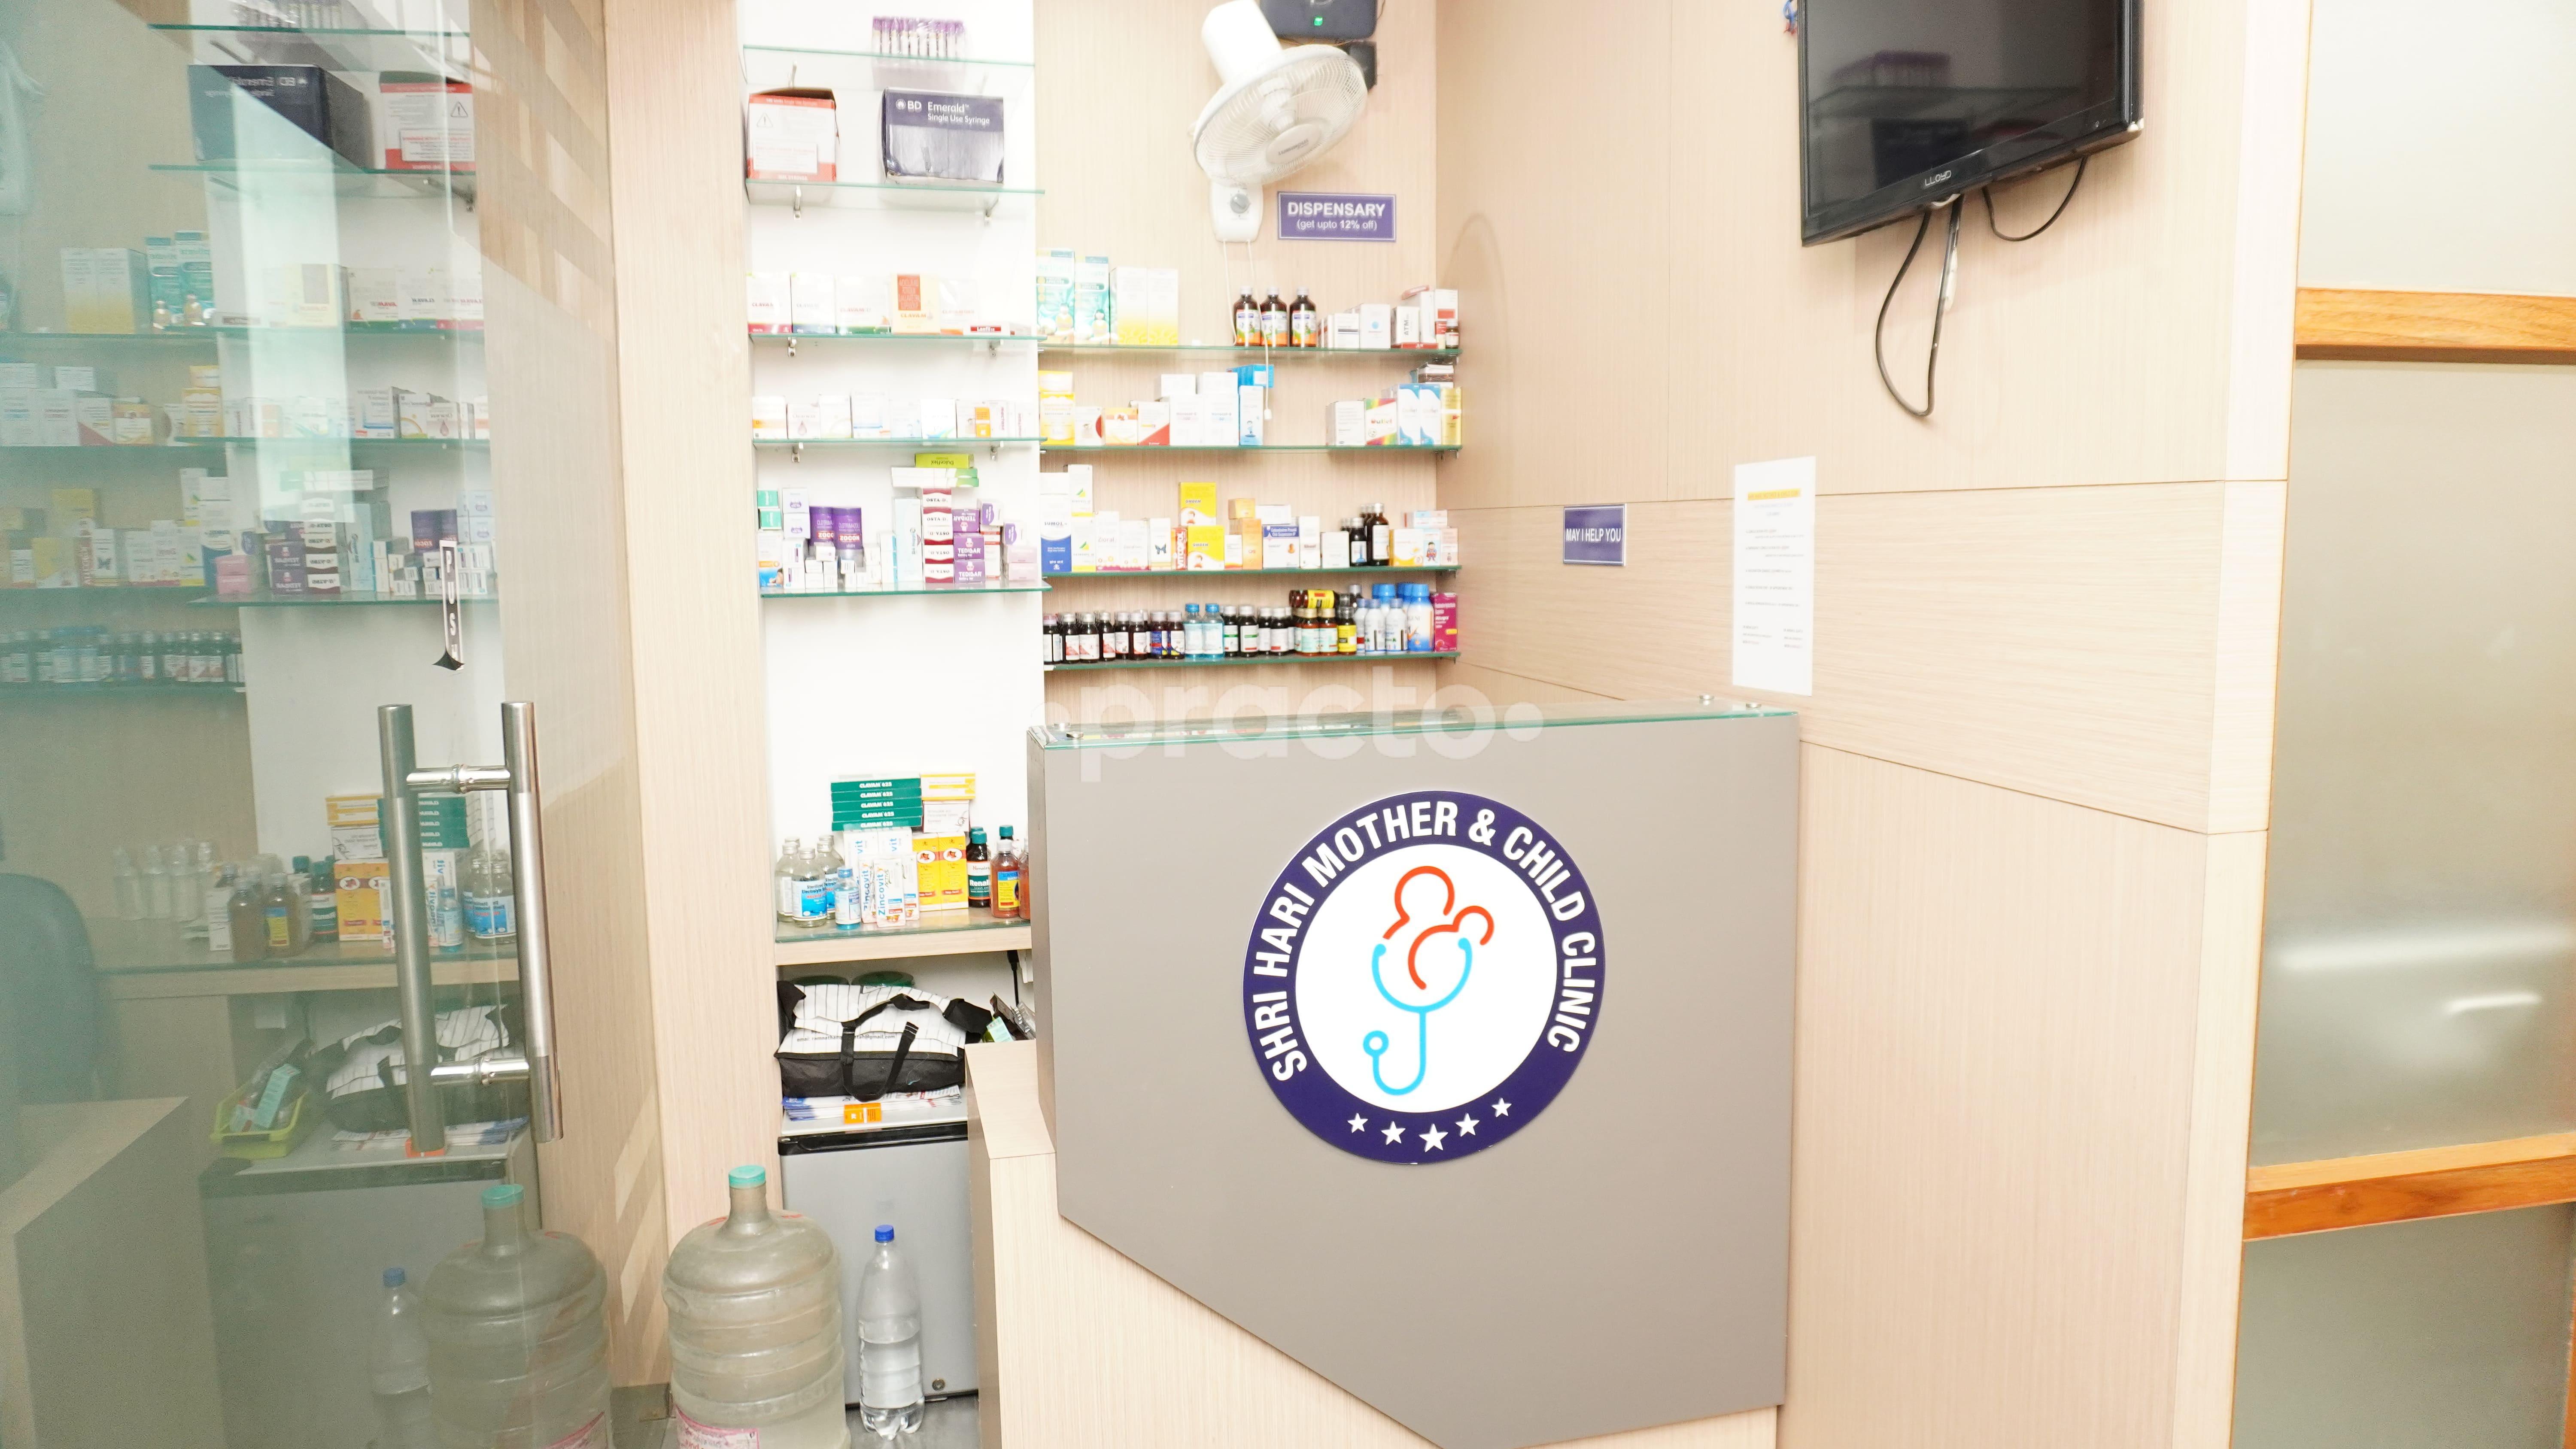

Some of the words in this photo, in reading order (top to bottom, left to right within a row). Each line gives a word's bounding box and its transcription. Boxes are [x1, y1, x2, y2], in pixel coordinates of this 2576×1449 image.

[908, 101, 921, 109] BD
[928, 113, 948, 122] Single
[965, 116, 990, 125] Syringe
[1925, 170, 1952, 186] LLOYD
[1288, 202, 1385, 216] DISPENSARY
[1297, 219, 1315, 230] (get
[1317, 220, 1337, 230] upto
[1340, 220, 1360, 229] 12%
[1362, 220, 1377, 230] off)
[1566, 528, 1580, 541] MAY
[1582, 528, 1584, 541] I
[1586, 528, 1604, 542] HELP
[1605, 528, 1621, 542] YOU
[1303, 801, 1458, 888] MOTHER
[1468, 808, 1496, 846] &
[1502, 825, 1586, 922] CHILD
[876, 873, 886, 916] Zincovit
[1253, 882, 1315, 977] HARI
[1546, 931, 1596, 1053] CLINIC
[1253, 991, 1307, 1082] SHRI
